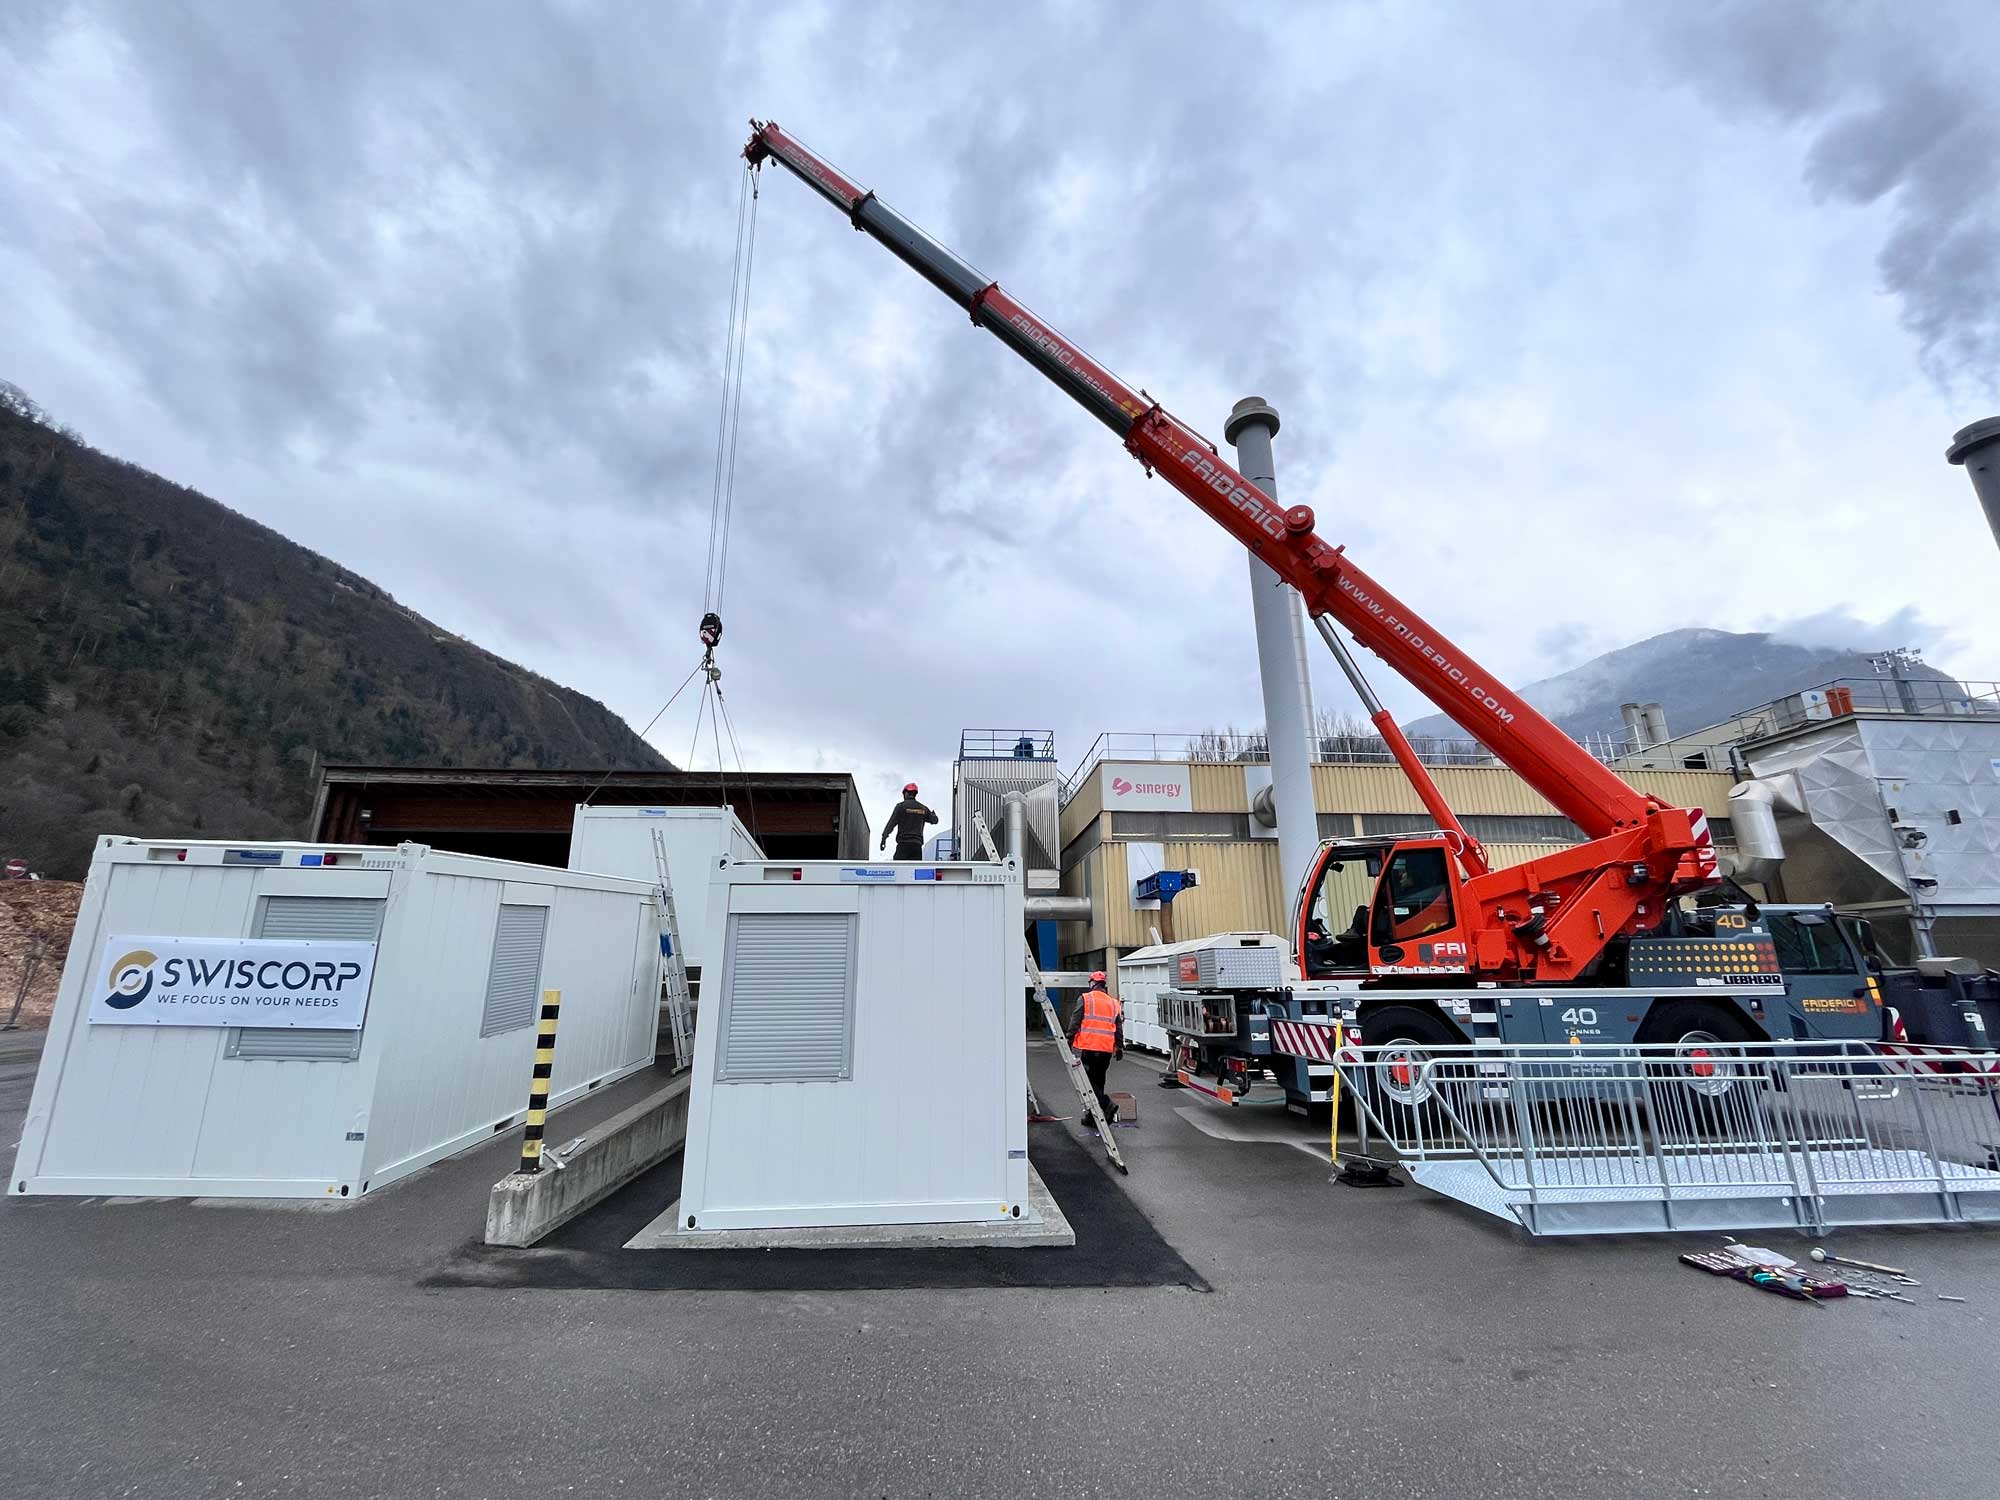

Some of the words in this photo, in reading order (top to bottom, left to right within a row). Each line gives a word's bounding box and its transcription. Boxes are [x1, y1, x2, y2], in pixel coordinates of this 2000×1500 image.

[1010, 314, 1075, 367] FRIDERICI
[1338, 575, 1515, 724] WWW.FRIDERICI.COM
[1135, 783, 1181, 797] sinergy
[1716, 914, 1746, 929] 40
[161, 958, 361, 991] SWISCORP
[1723, 975, 1782, 985] LIEBHERR
[157, 994, 178, 1004] WE
[182, 995, 226, 1005] FOCUS
[231, 996, 250, 1006] ON
[255, 996, 291, 1006] YOUR
[295, 997, 339, 1007] NEEDS
[1802, 999, 1857, 1008] FRIDERICI
[1561, 1008, 1597, 1025] 40
